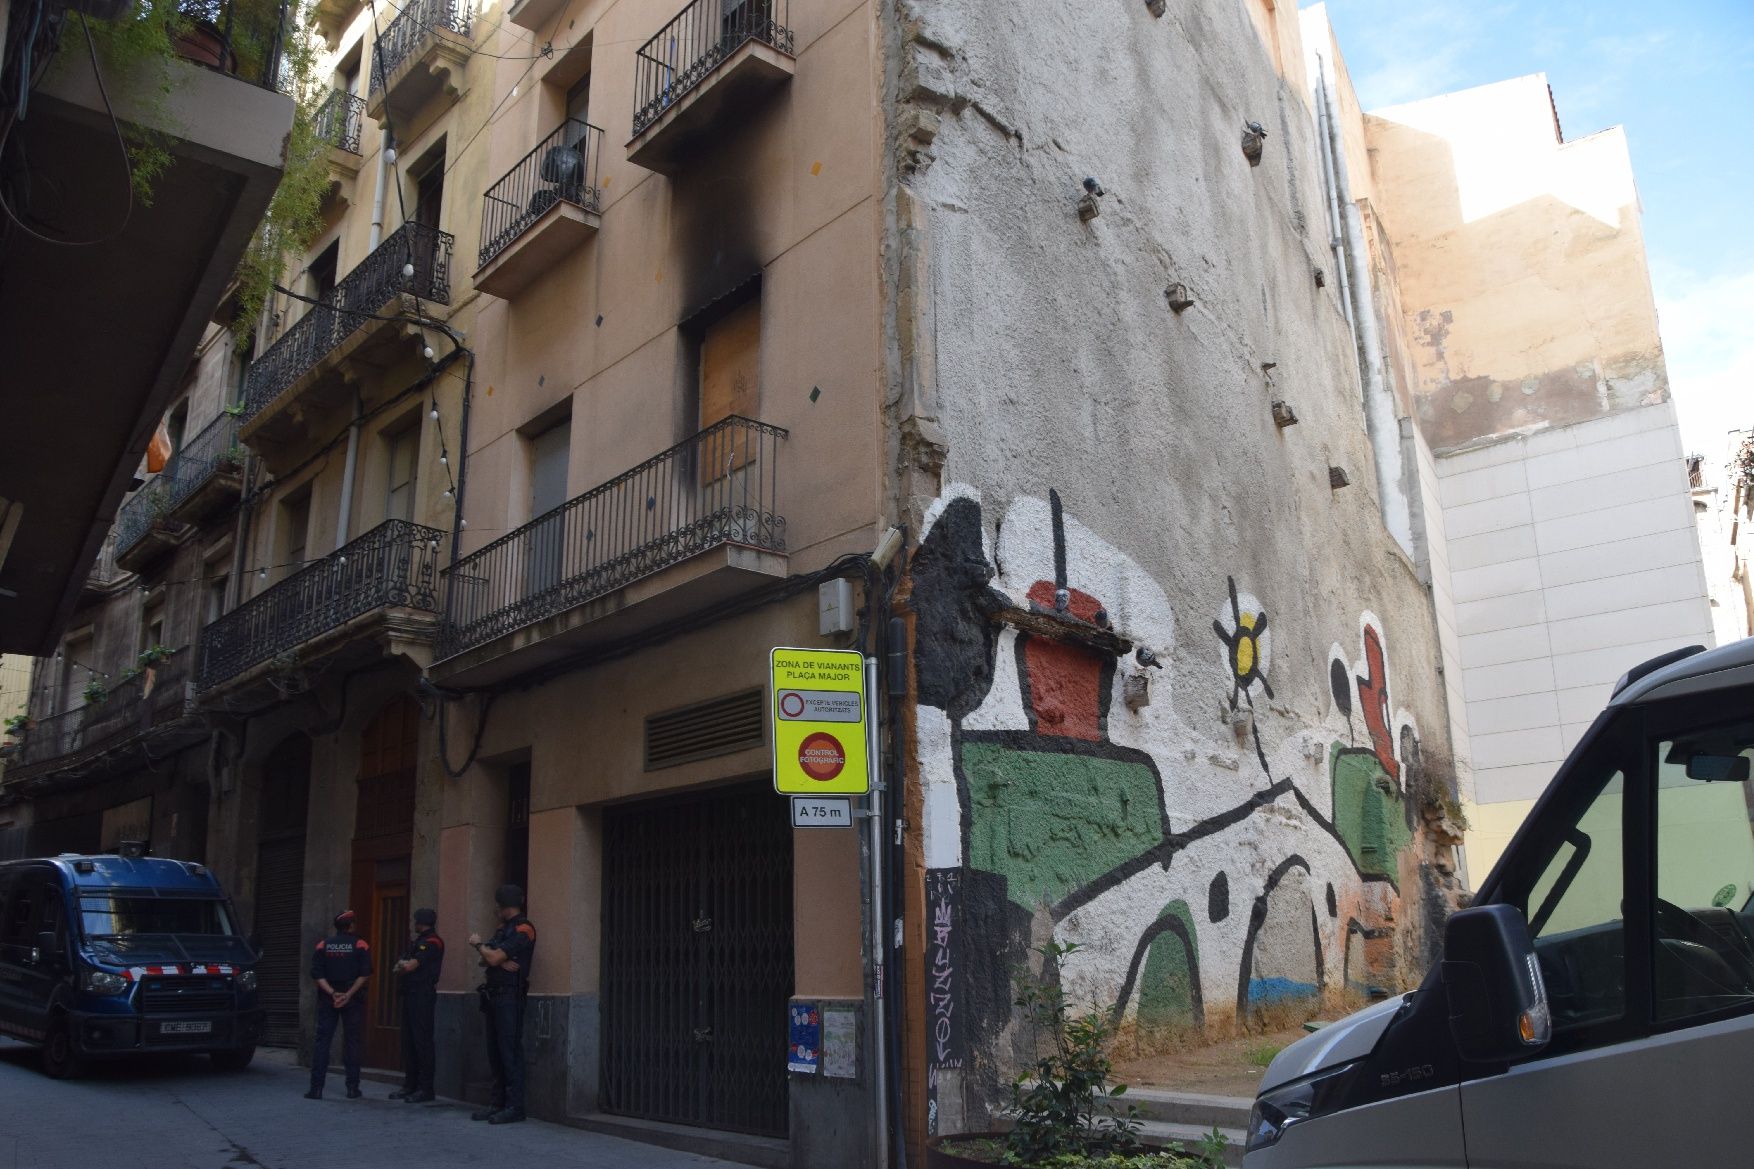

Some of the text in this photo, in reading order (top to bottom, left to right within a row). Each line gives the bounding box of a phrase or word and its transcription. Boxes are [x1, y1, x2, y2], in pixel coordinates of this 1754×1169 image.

[803, 661, 815, 669] DE
[817, 662, 860, 671] VIANANTS
[787, 671, 850, 681] PLAÇA MAJOR
[800, 806, 841, 817] A 75 m
